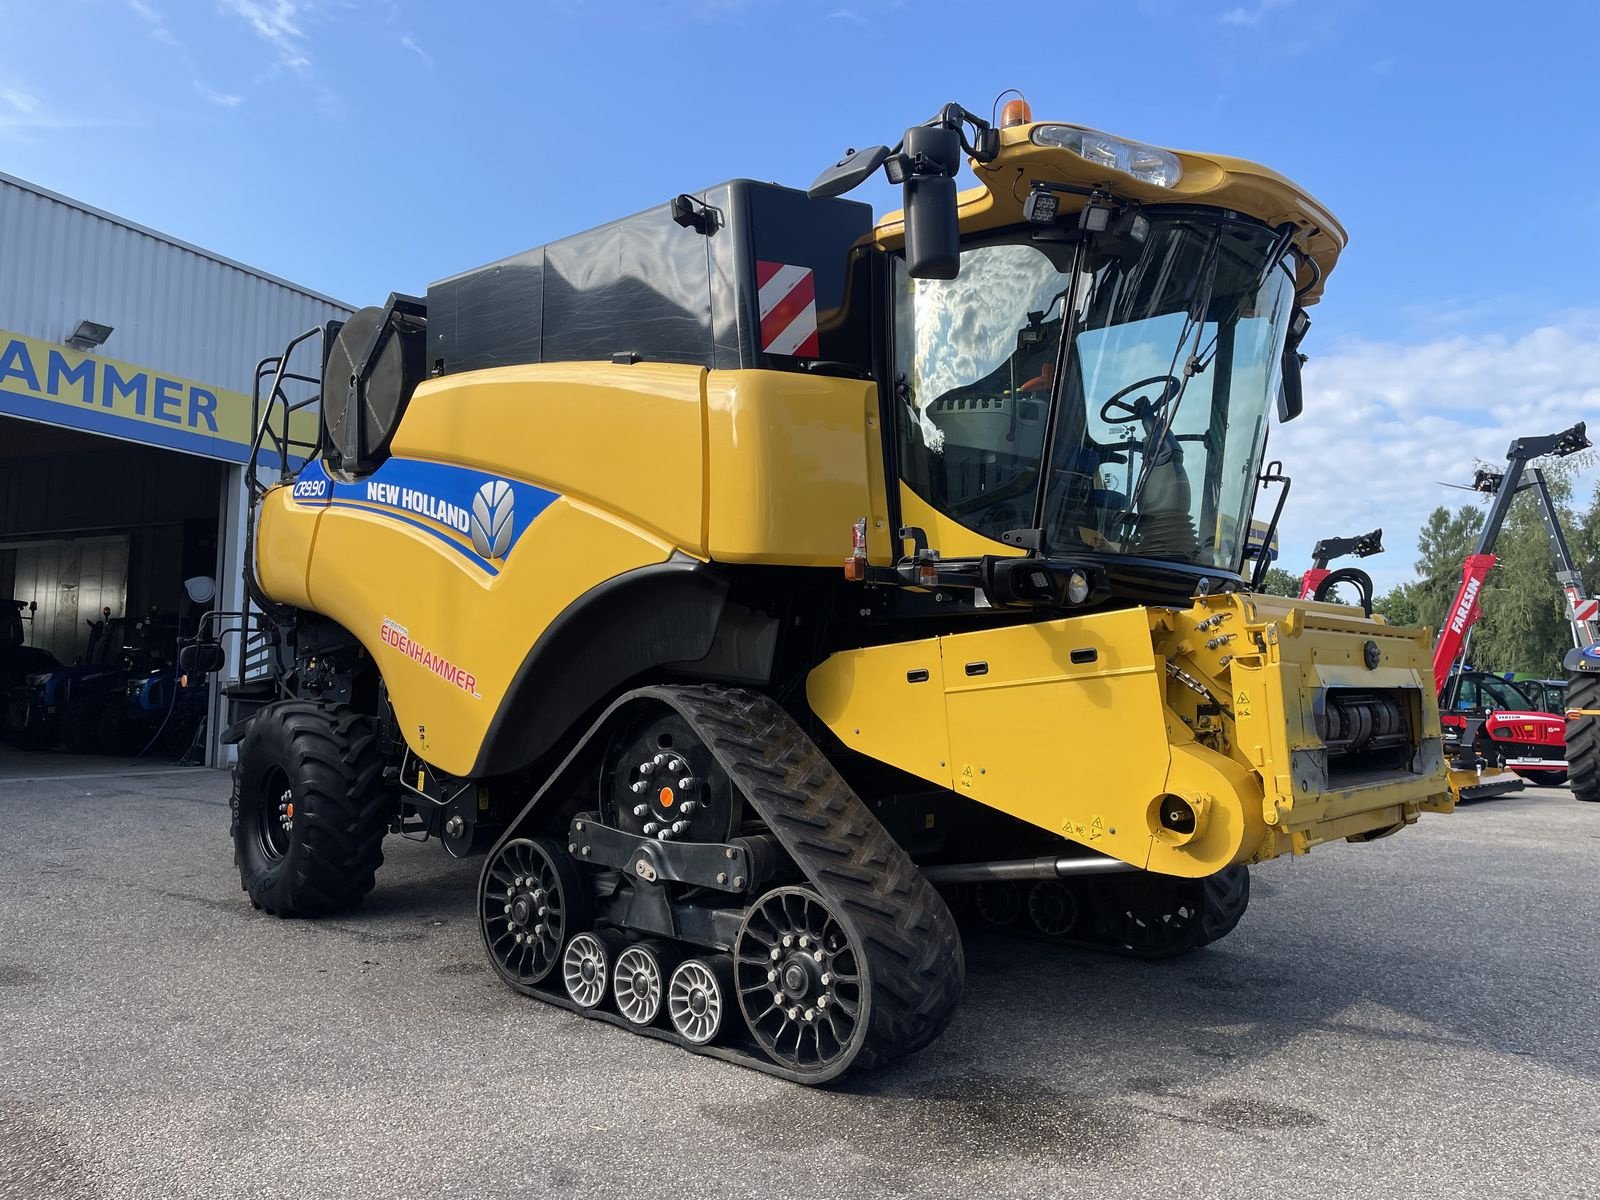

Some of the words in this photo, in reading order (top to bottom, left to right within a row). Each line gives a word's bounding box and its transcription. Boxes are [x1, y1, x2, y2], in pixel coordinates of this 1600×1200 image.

[0, 339, 219, 432] AMMER
[294, 480, 326, 497] CR9.90
[367, 482, 400, 504] NEW
[402, 488, 470, 533] HOLLAND
[1451, 576, 1480, 634] FARESIN
[380, 624, 476, 694] EIDENHAMMER
